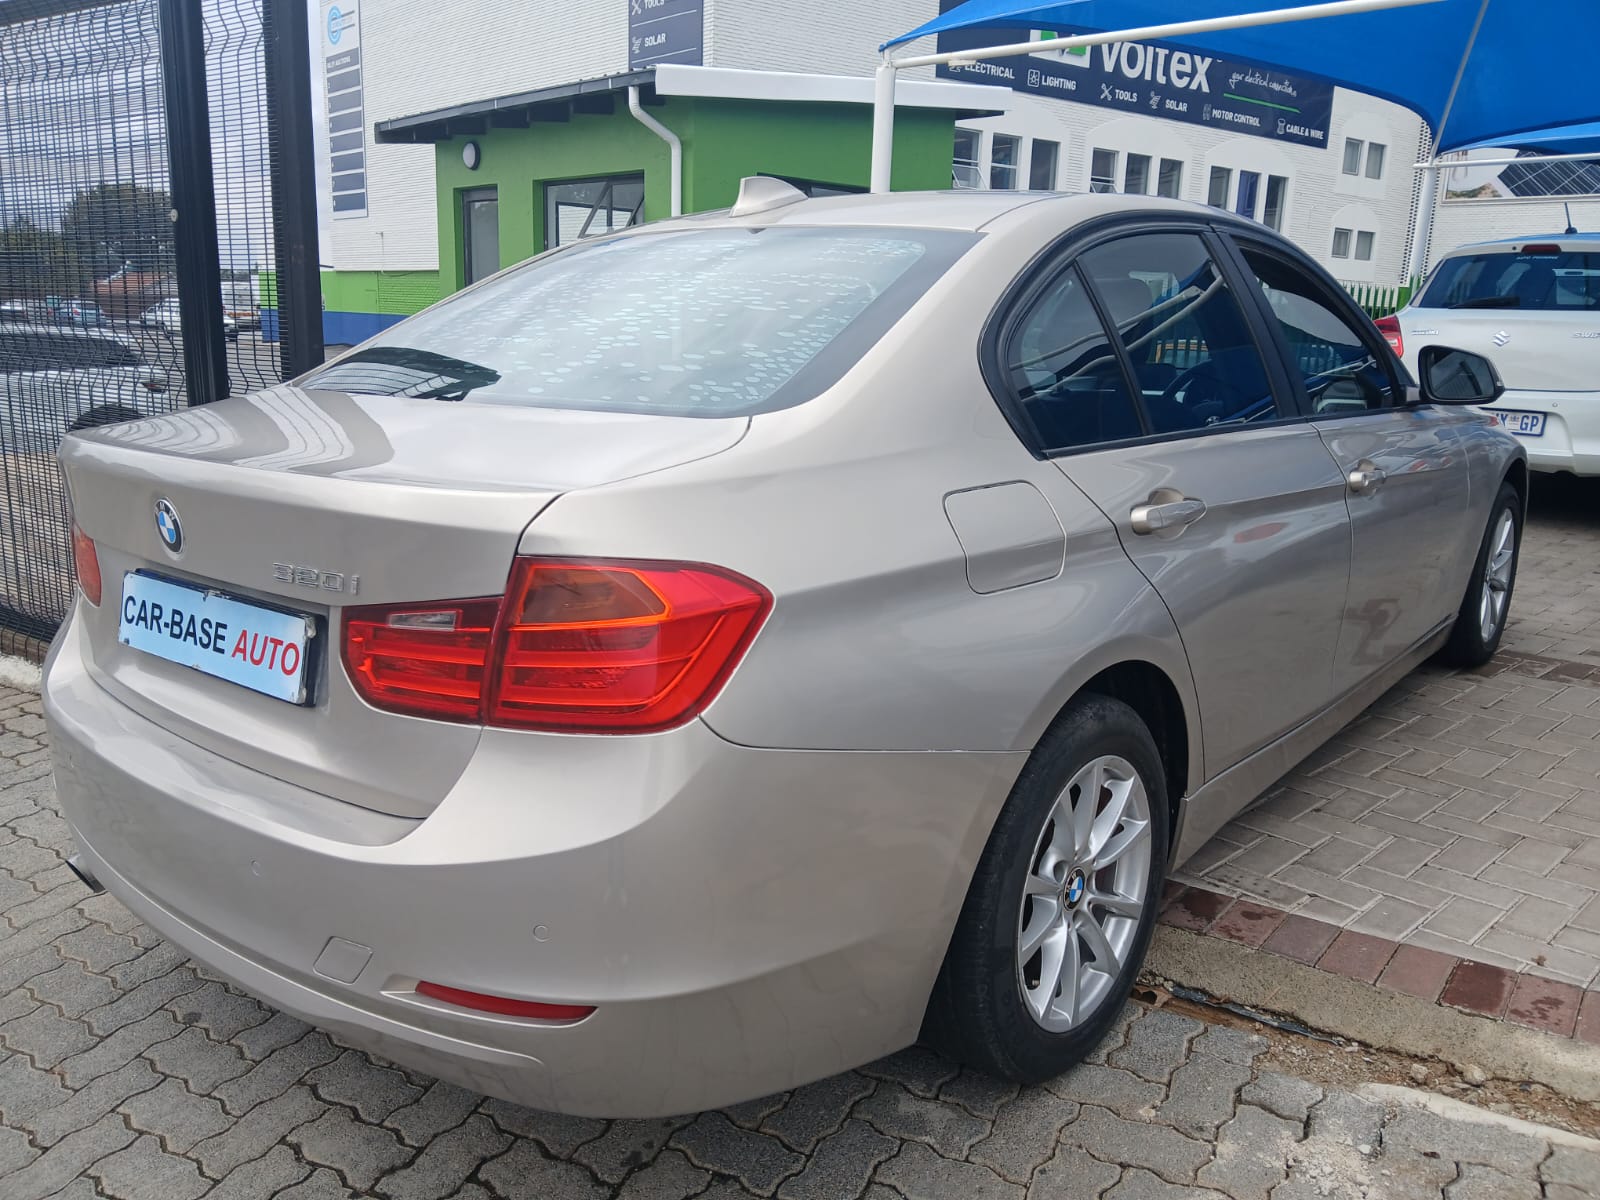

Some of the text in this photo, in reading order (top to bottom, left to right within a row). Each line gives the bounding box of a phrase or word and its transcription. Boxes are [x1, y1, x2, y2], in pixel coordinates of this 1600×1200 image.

[645, 33, 666, 47] SOLAR
[965, 62, 1015, 79] ELECTRICAL
[1041, 75, 1077, 90] LIGHTING
[1115, 89, 1138, 102] TOOLS
[1165, 99, 1188, 112] SOLAR
[1212, 108, 1261, 127] MOTOR CONTROL
[1286, 124, 1304, 136] CABLE
[1310, 128, 1324, 139] WIRE
[1520, 415, 1540, 432] GP
[124, 596, 300, 676] CAR-BASE AUTO
